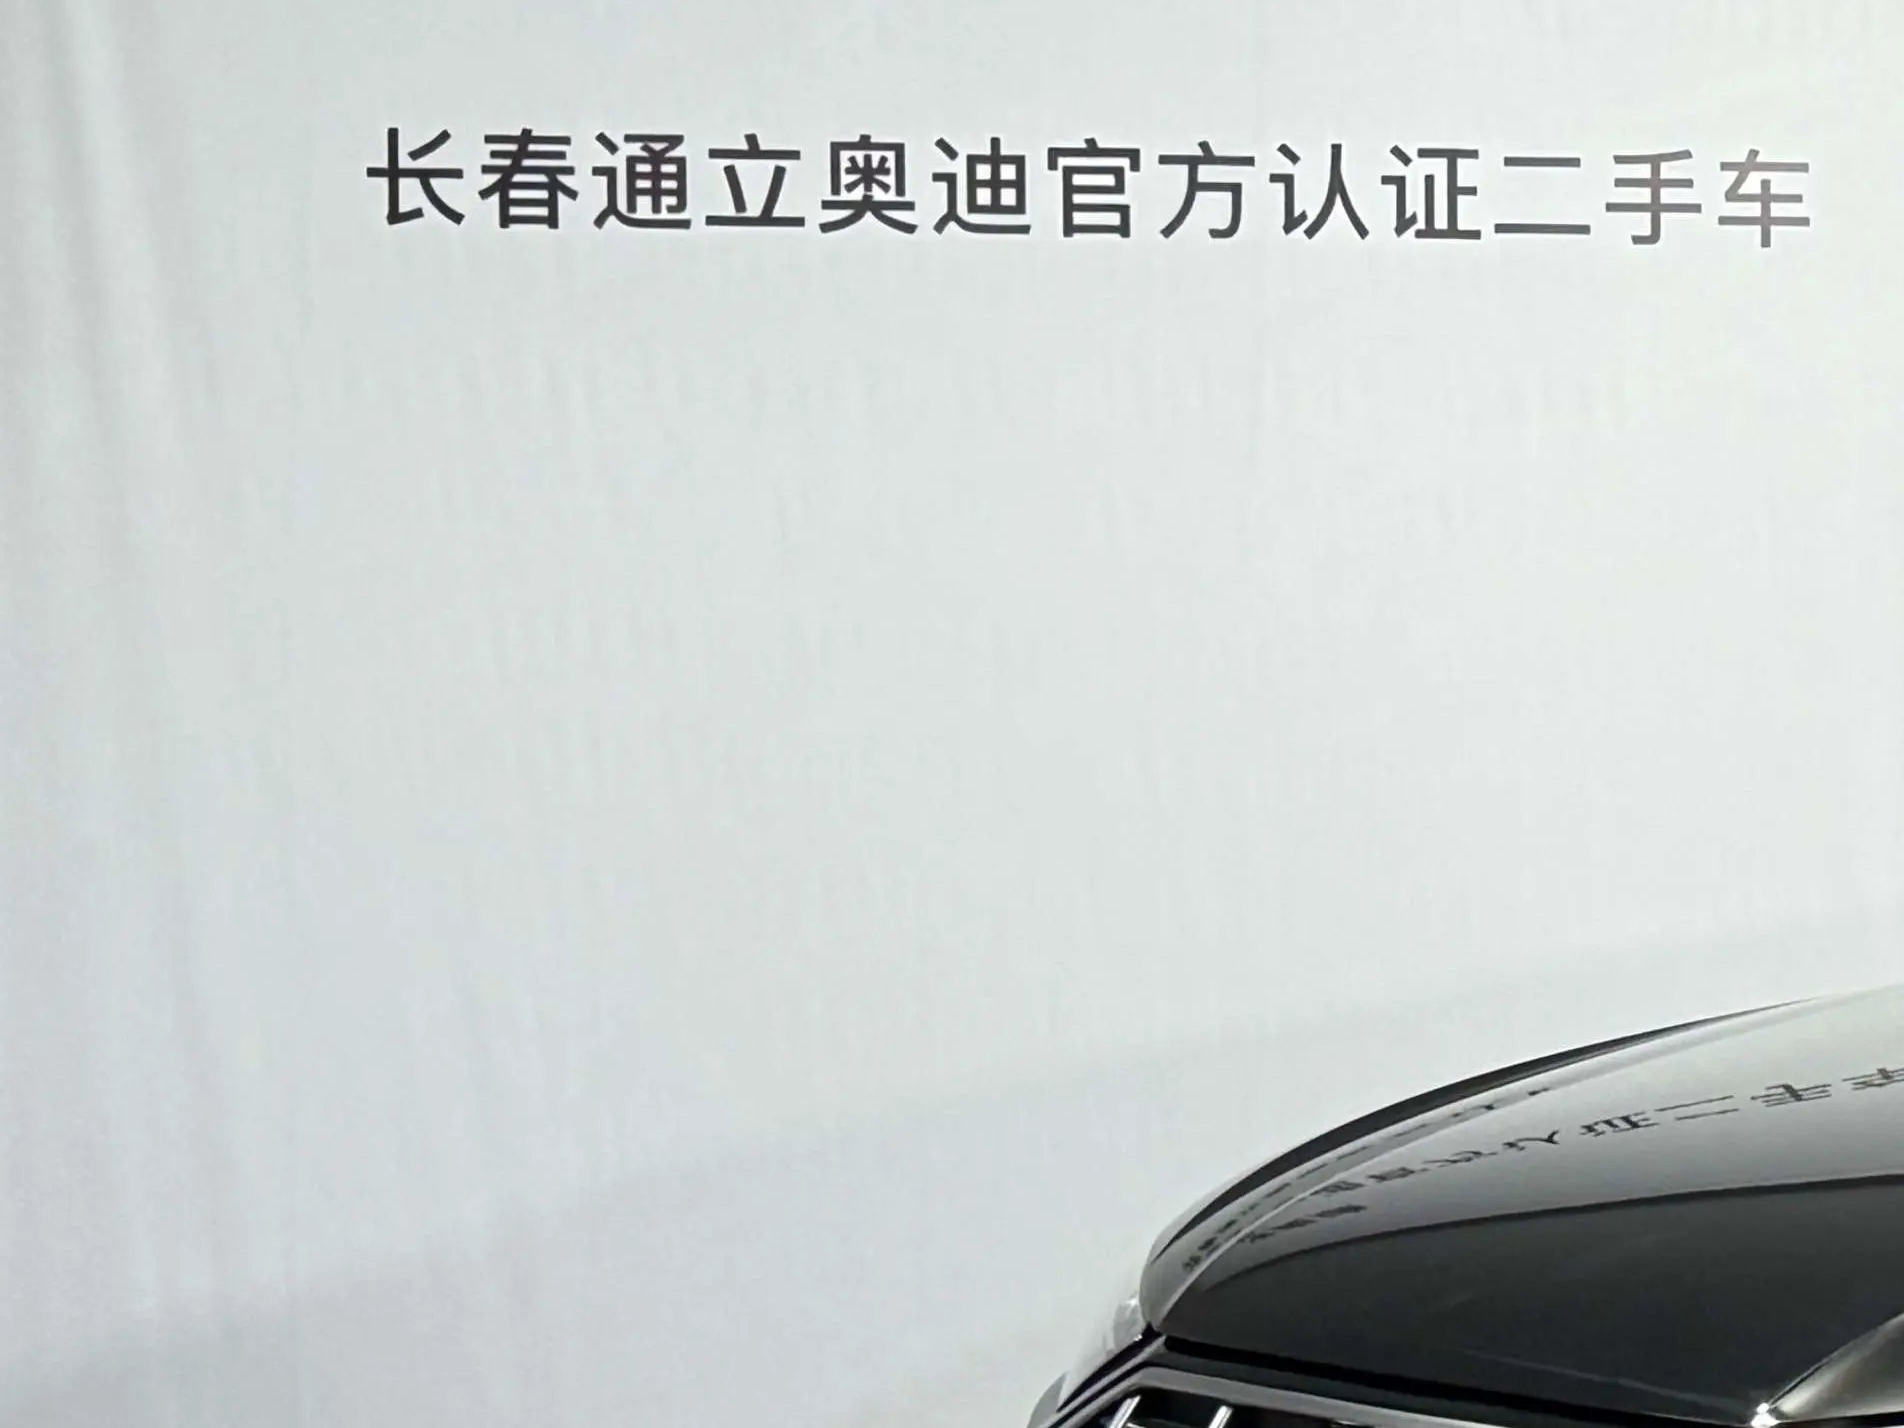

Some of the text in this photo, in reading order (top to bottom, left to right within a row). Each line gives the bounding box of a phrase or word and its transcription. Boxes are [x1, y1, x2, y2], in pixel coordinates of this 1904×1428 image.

[365, 126, 1813, 249] 长春通立奥迪官方认证二手车
